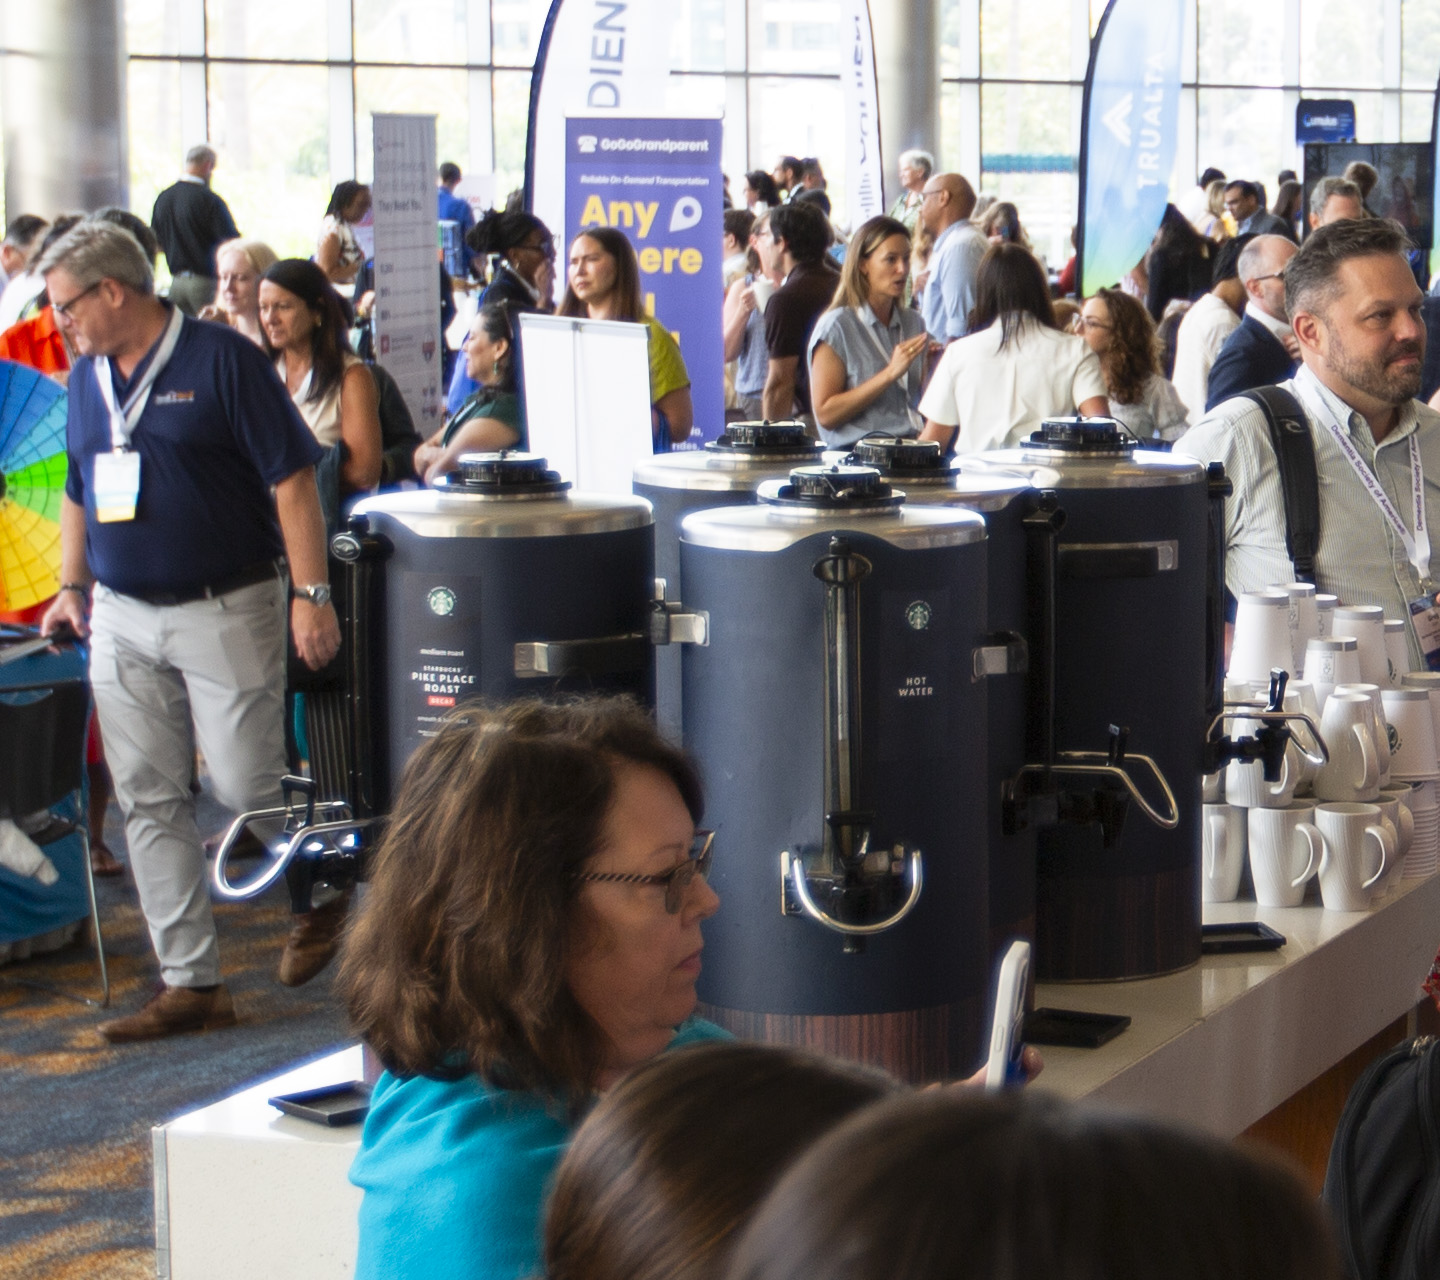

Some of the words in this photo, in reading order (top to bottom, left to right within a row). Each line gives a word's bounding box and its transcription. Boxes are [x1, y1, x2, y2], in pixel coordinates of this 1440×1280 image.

[1137, 51, 1166, 190] TRUALTA
[601, 138, 709, 153] GoGoGrandparent
[580, 175, 609, 184] Reliable
[610, 176, 655, 185] On-Demand
[656, 176, 709, 187] Transportation
[580, 194, 659, 239] Any
[635, 247, 703, 274] ere
[1330, 423, 1357, 462] Dementia
[1354, 457, 1375, 491] Society
[1373, 487, 1383, 500] of
[1414, 467, 1422, 500] Society
[1415, 499, 1424, 532] Dementia
[412, 672, 435, 682] PIKE
[439, 674, 474, 684] PLACE
[906, 677, 927, 686] HOT
[424, 683, 461, 694] ROAST
[899, 687, 933, 696] WATER
[430, 696, 454, 706] DECAF
